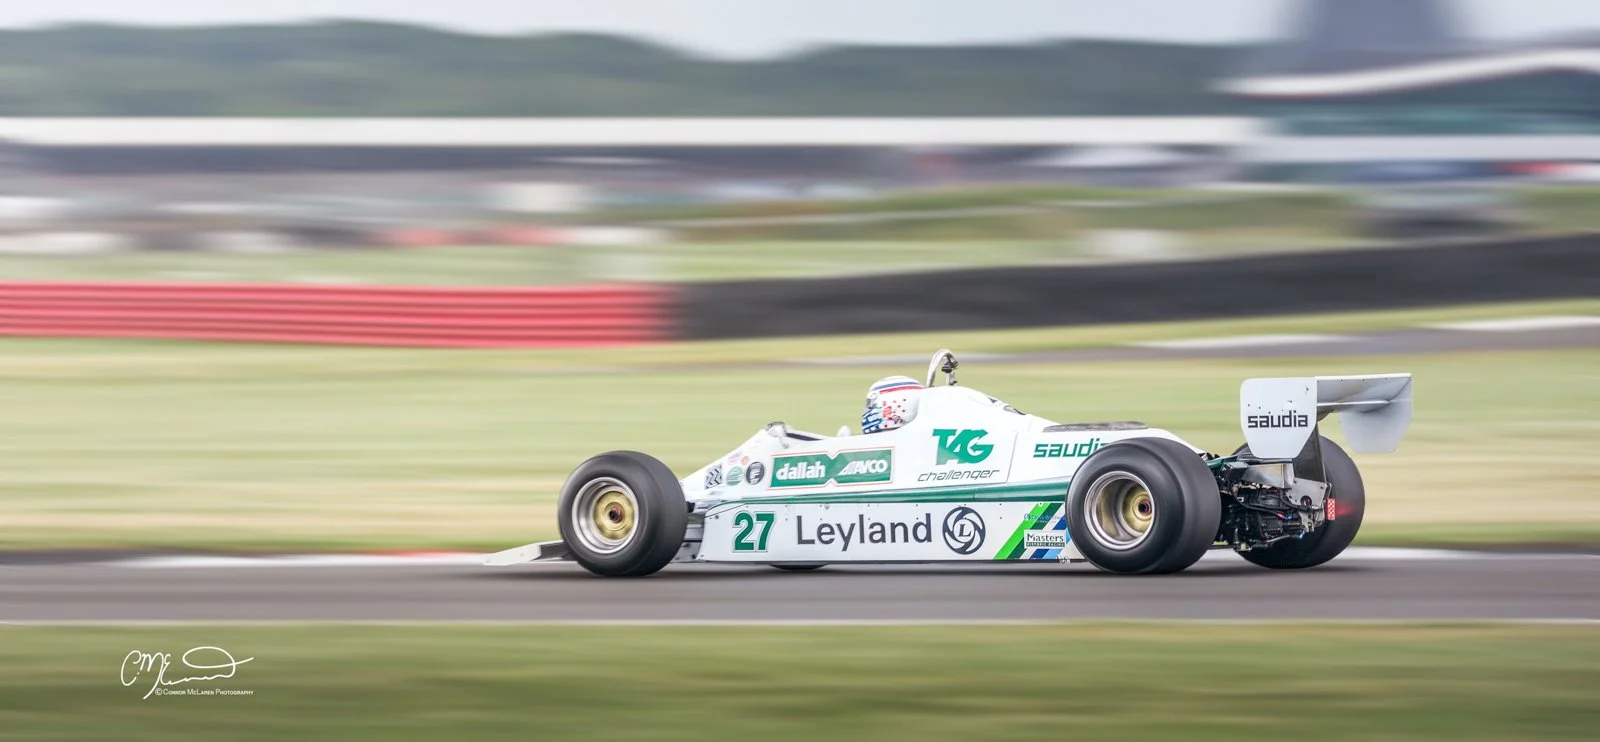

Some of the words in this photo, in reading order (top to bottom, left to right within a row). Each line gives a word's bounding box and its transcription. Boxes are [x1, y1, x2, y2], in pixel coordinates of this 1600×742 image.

[1247, 410, 1309, 429] saudia
[932, 428, 994, 466] TAG
[1033, 437, 1109, 458] saudi
[775, 461, 826, 481] dallah
[917, 468, 1000, 483] challenger
[732, 510, 776, 553] 27
[796, 512, 933, 552] Leyland
[958, 523, 972, 538] L
[1027, 533, 1064, 542] Masters
